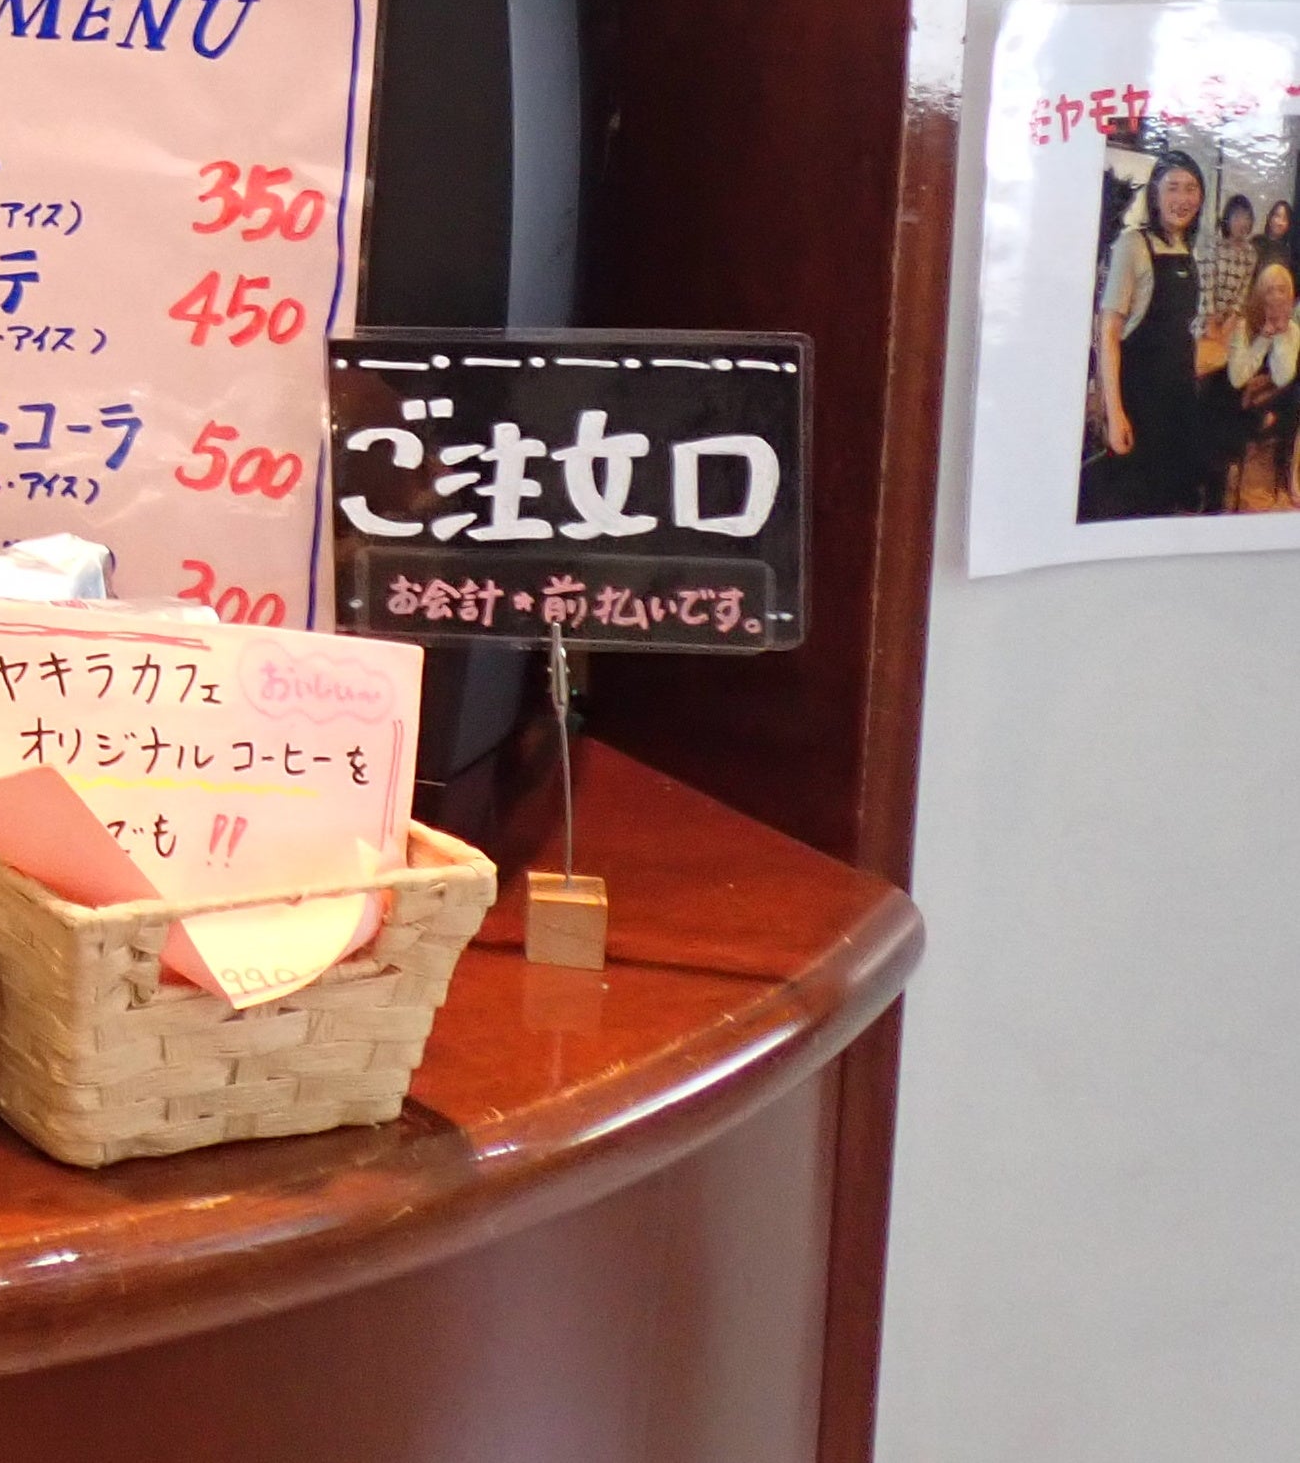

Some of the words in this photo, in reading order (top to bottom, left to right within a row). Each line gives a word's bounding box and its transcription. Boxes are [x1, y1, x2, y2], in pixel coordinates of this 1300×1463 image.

[191, 160, 325, 241] 350
[168, 270, 306, 347] 450
[174, 420, 303, 500] 500
[339, 398, 781, 541] ご注文口
